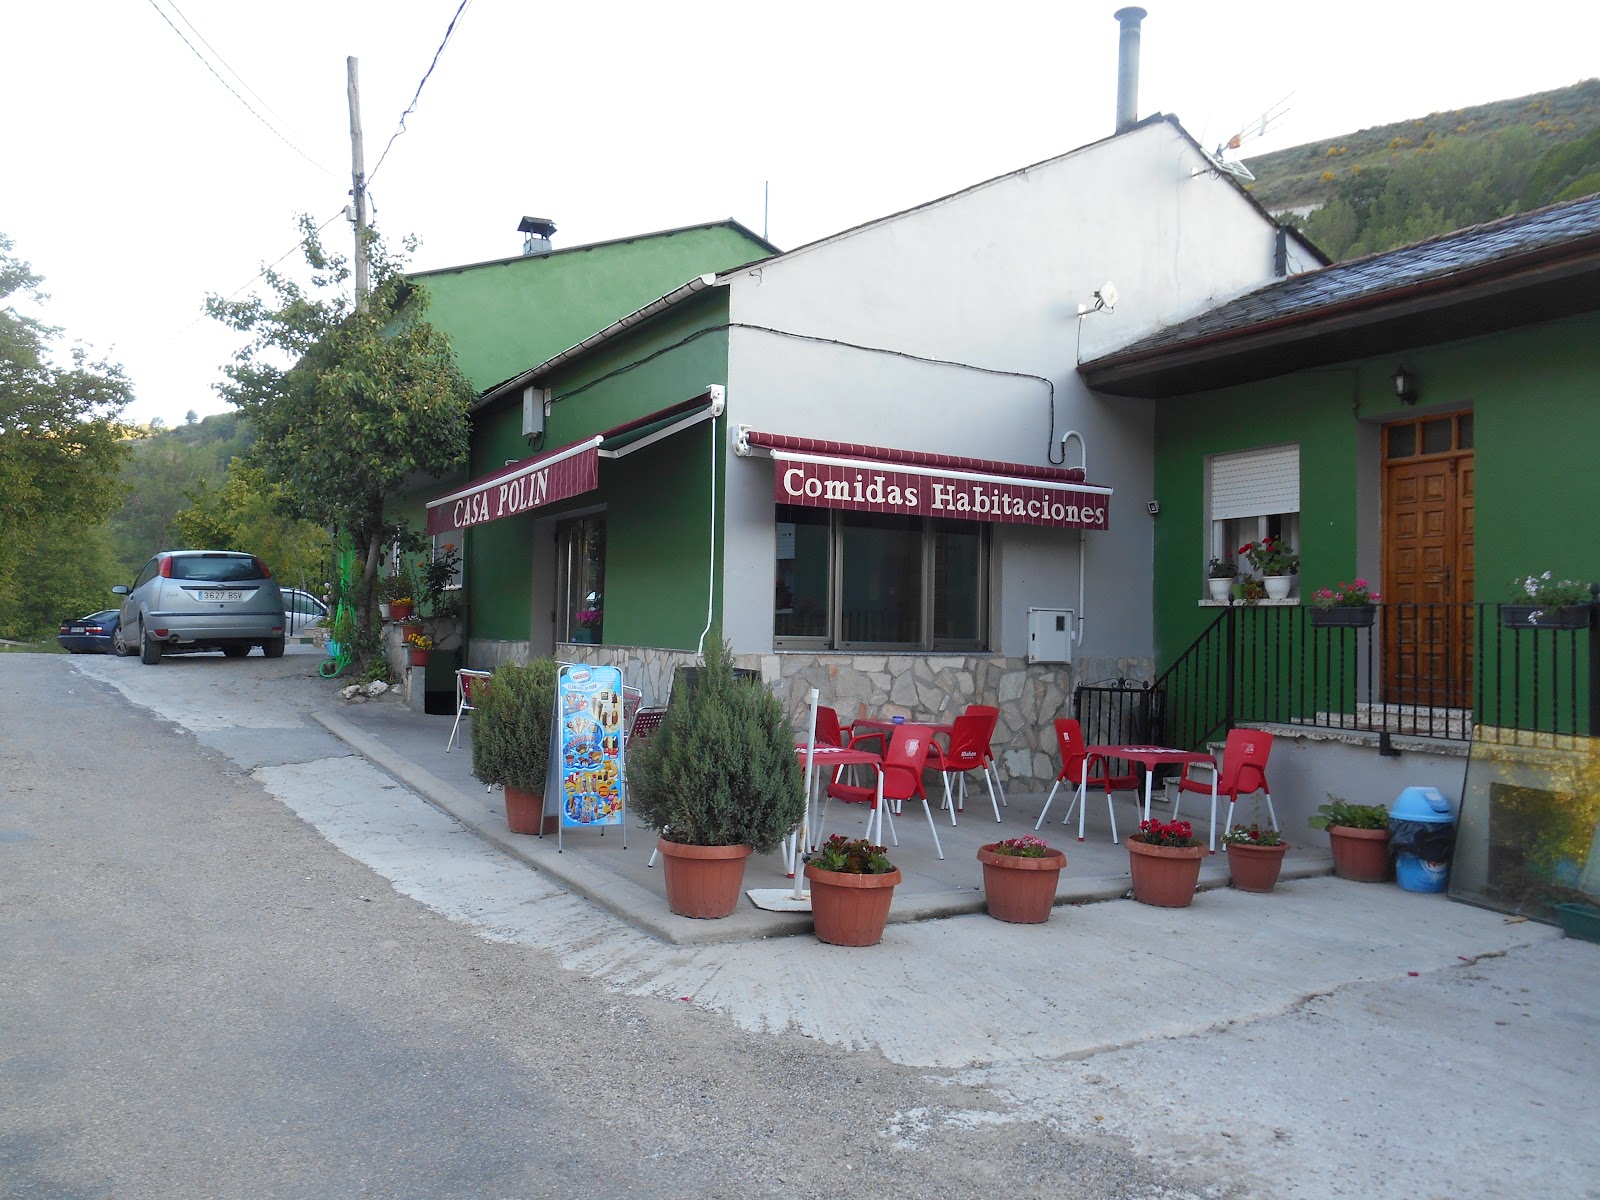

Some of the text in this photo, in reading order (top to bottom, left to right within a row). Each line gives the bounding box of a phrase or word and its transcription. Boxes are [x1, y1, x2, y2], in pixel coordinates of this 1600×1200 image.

[453, 468, 549, 528] CASA POLIN
[783, 468, 1105, 525] Comidas Habitaciones
[204, 591, 243, 600] 3627 BSV
